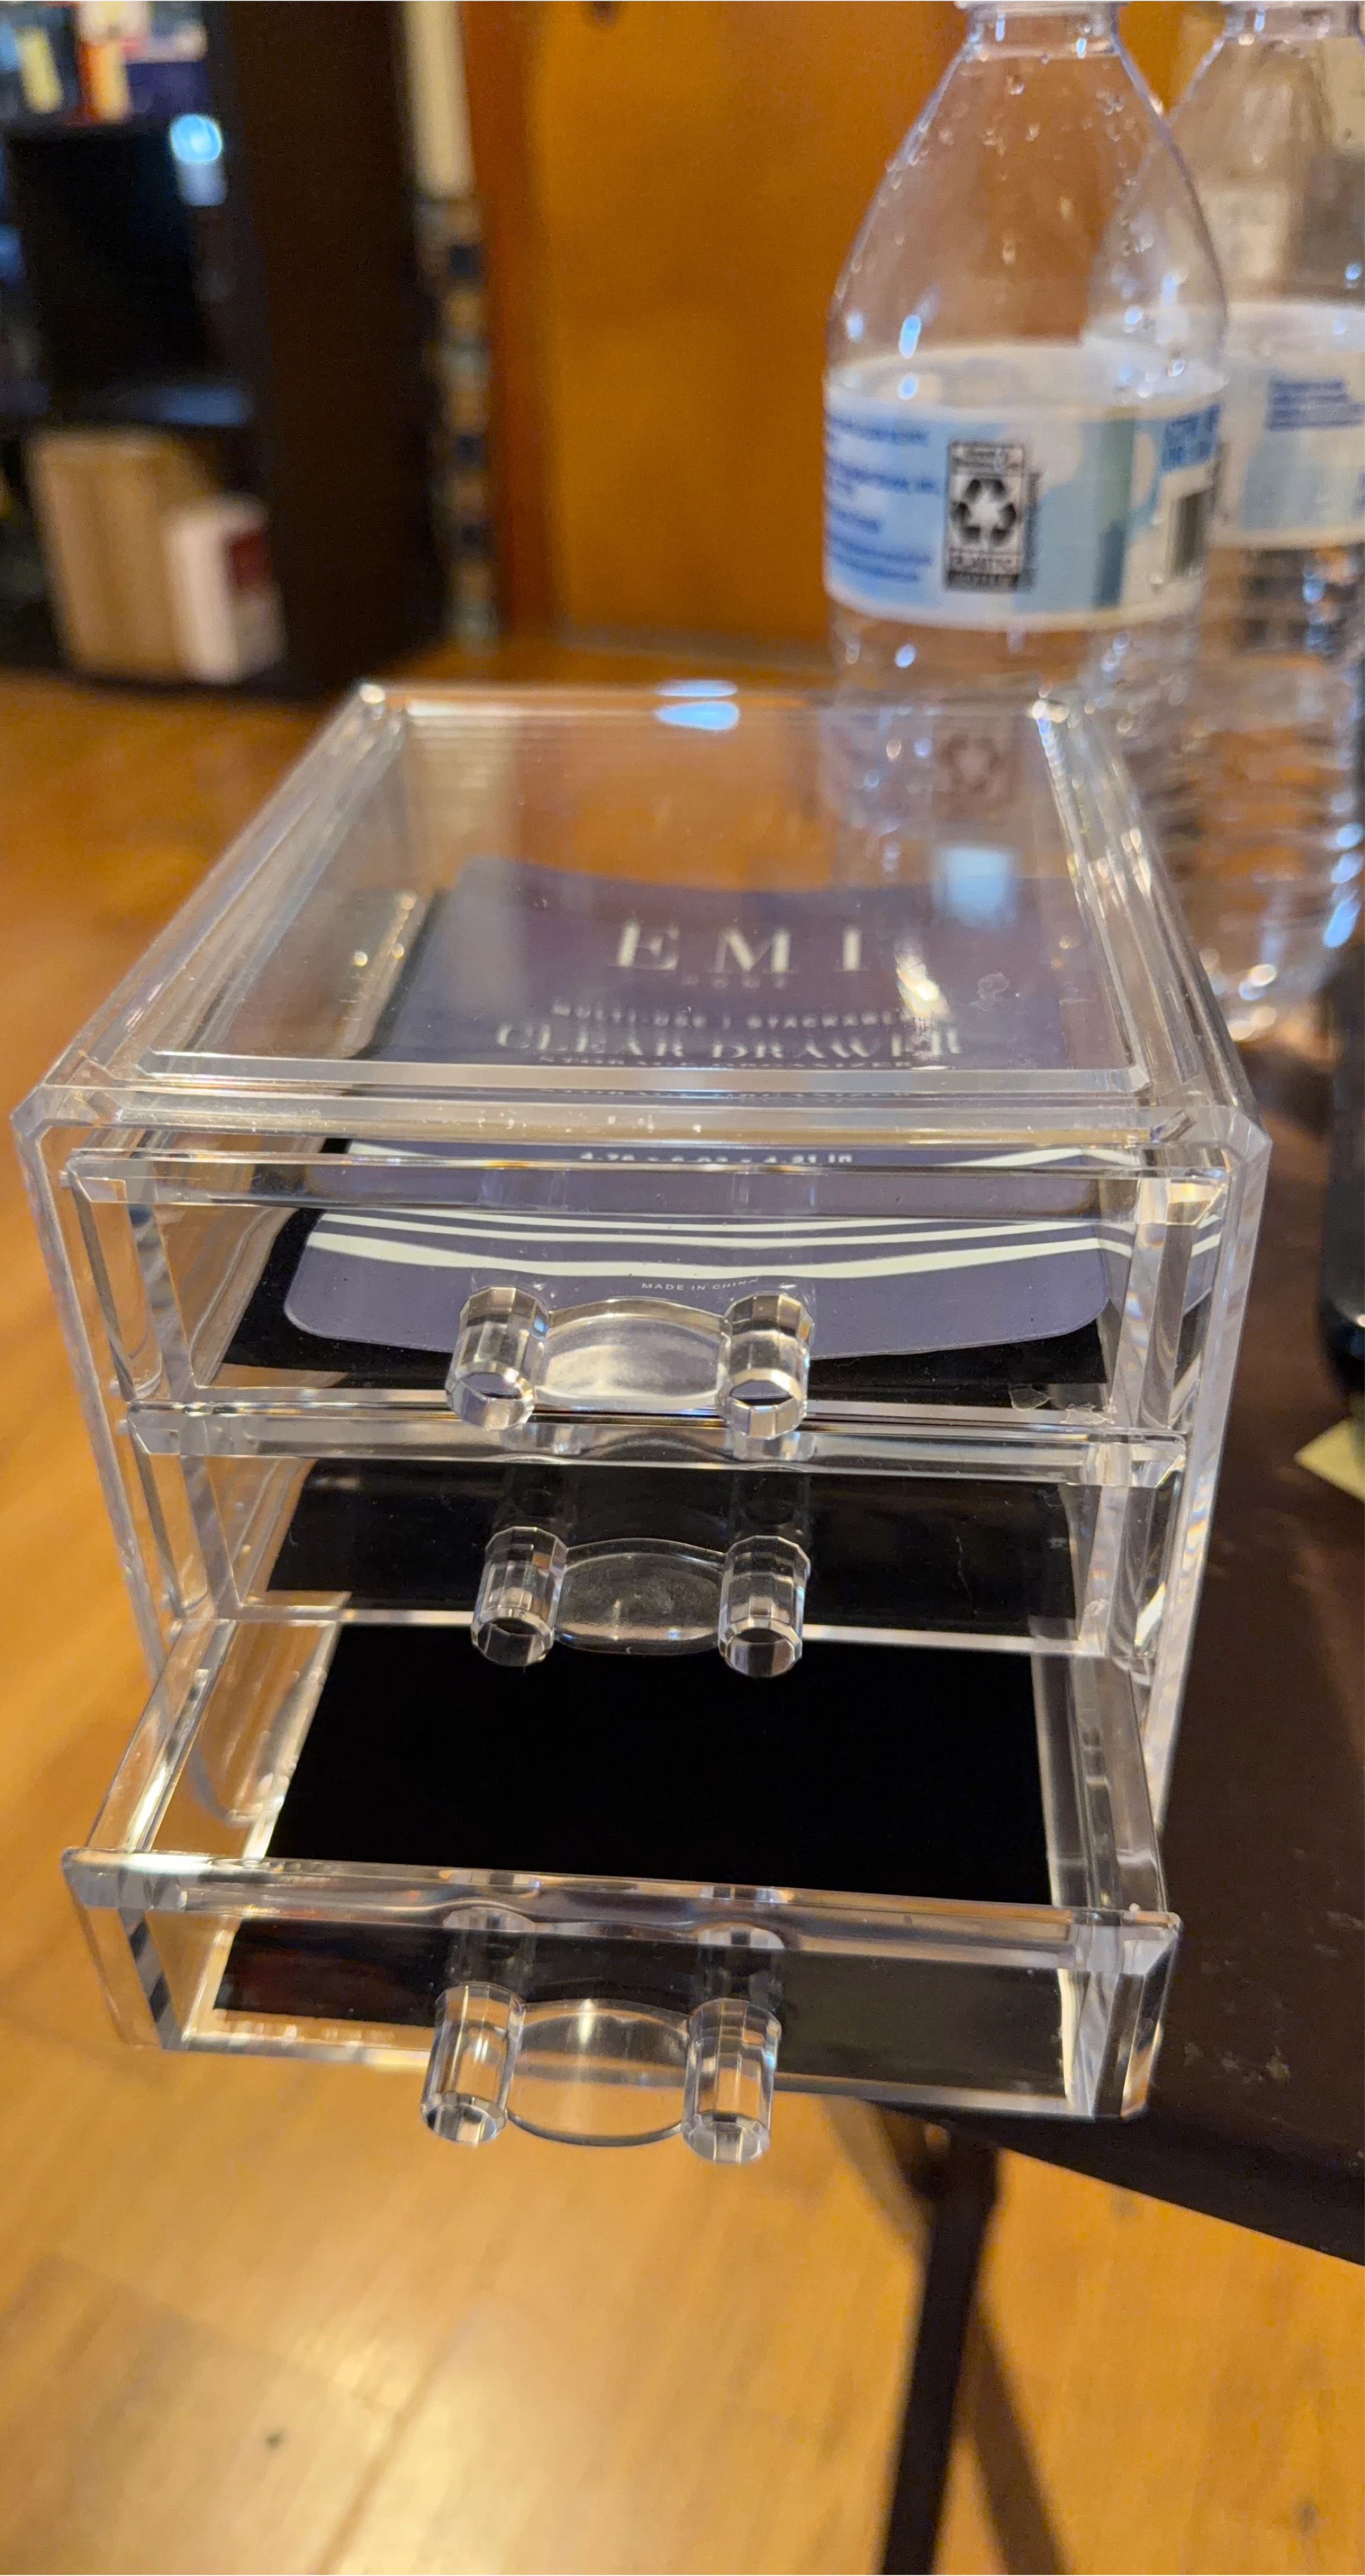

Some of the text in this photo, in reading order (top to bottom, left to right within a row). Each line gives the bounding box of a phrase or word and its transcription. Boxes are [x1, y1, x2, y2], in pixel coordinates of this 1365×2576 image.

[496, 1022, 684, 1058] CLEAR
[641, 1283, 685, 1291] MADE
[712, 1278, 759, 1290] CHINA
